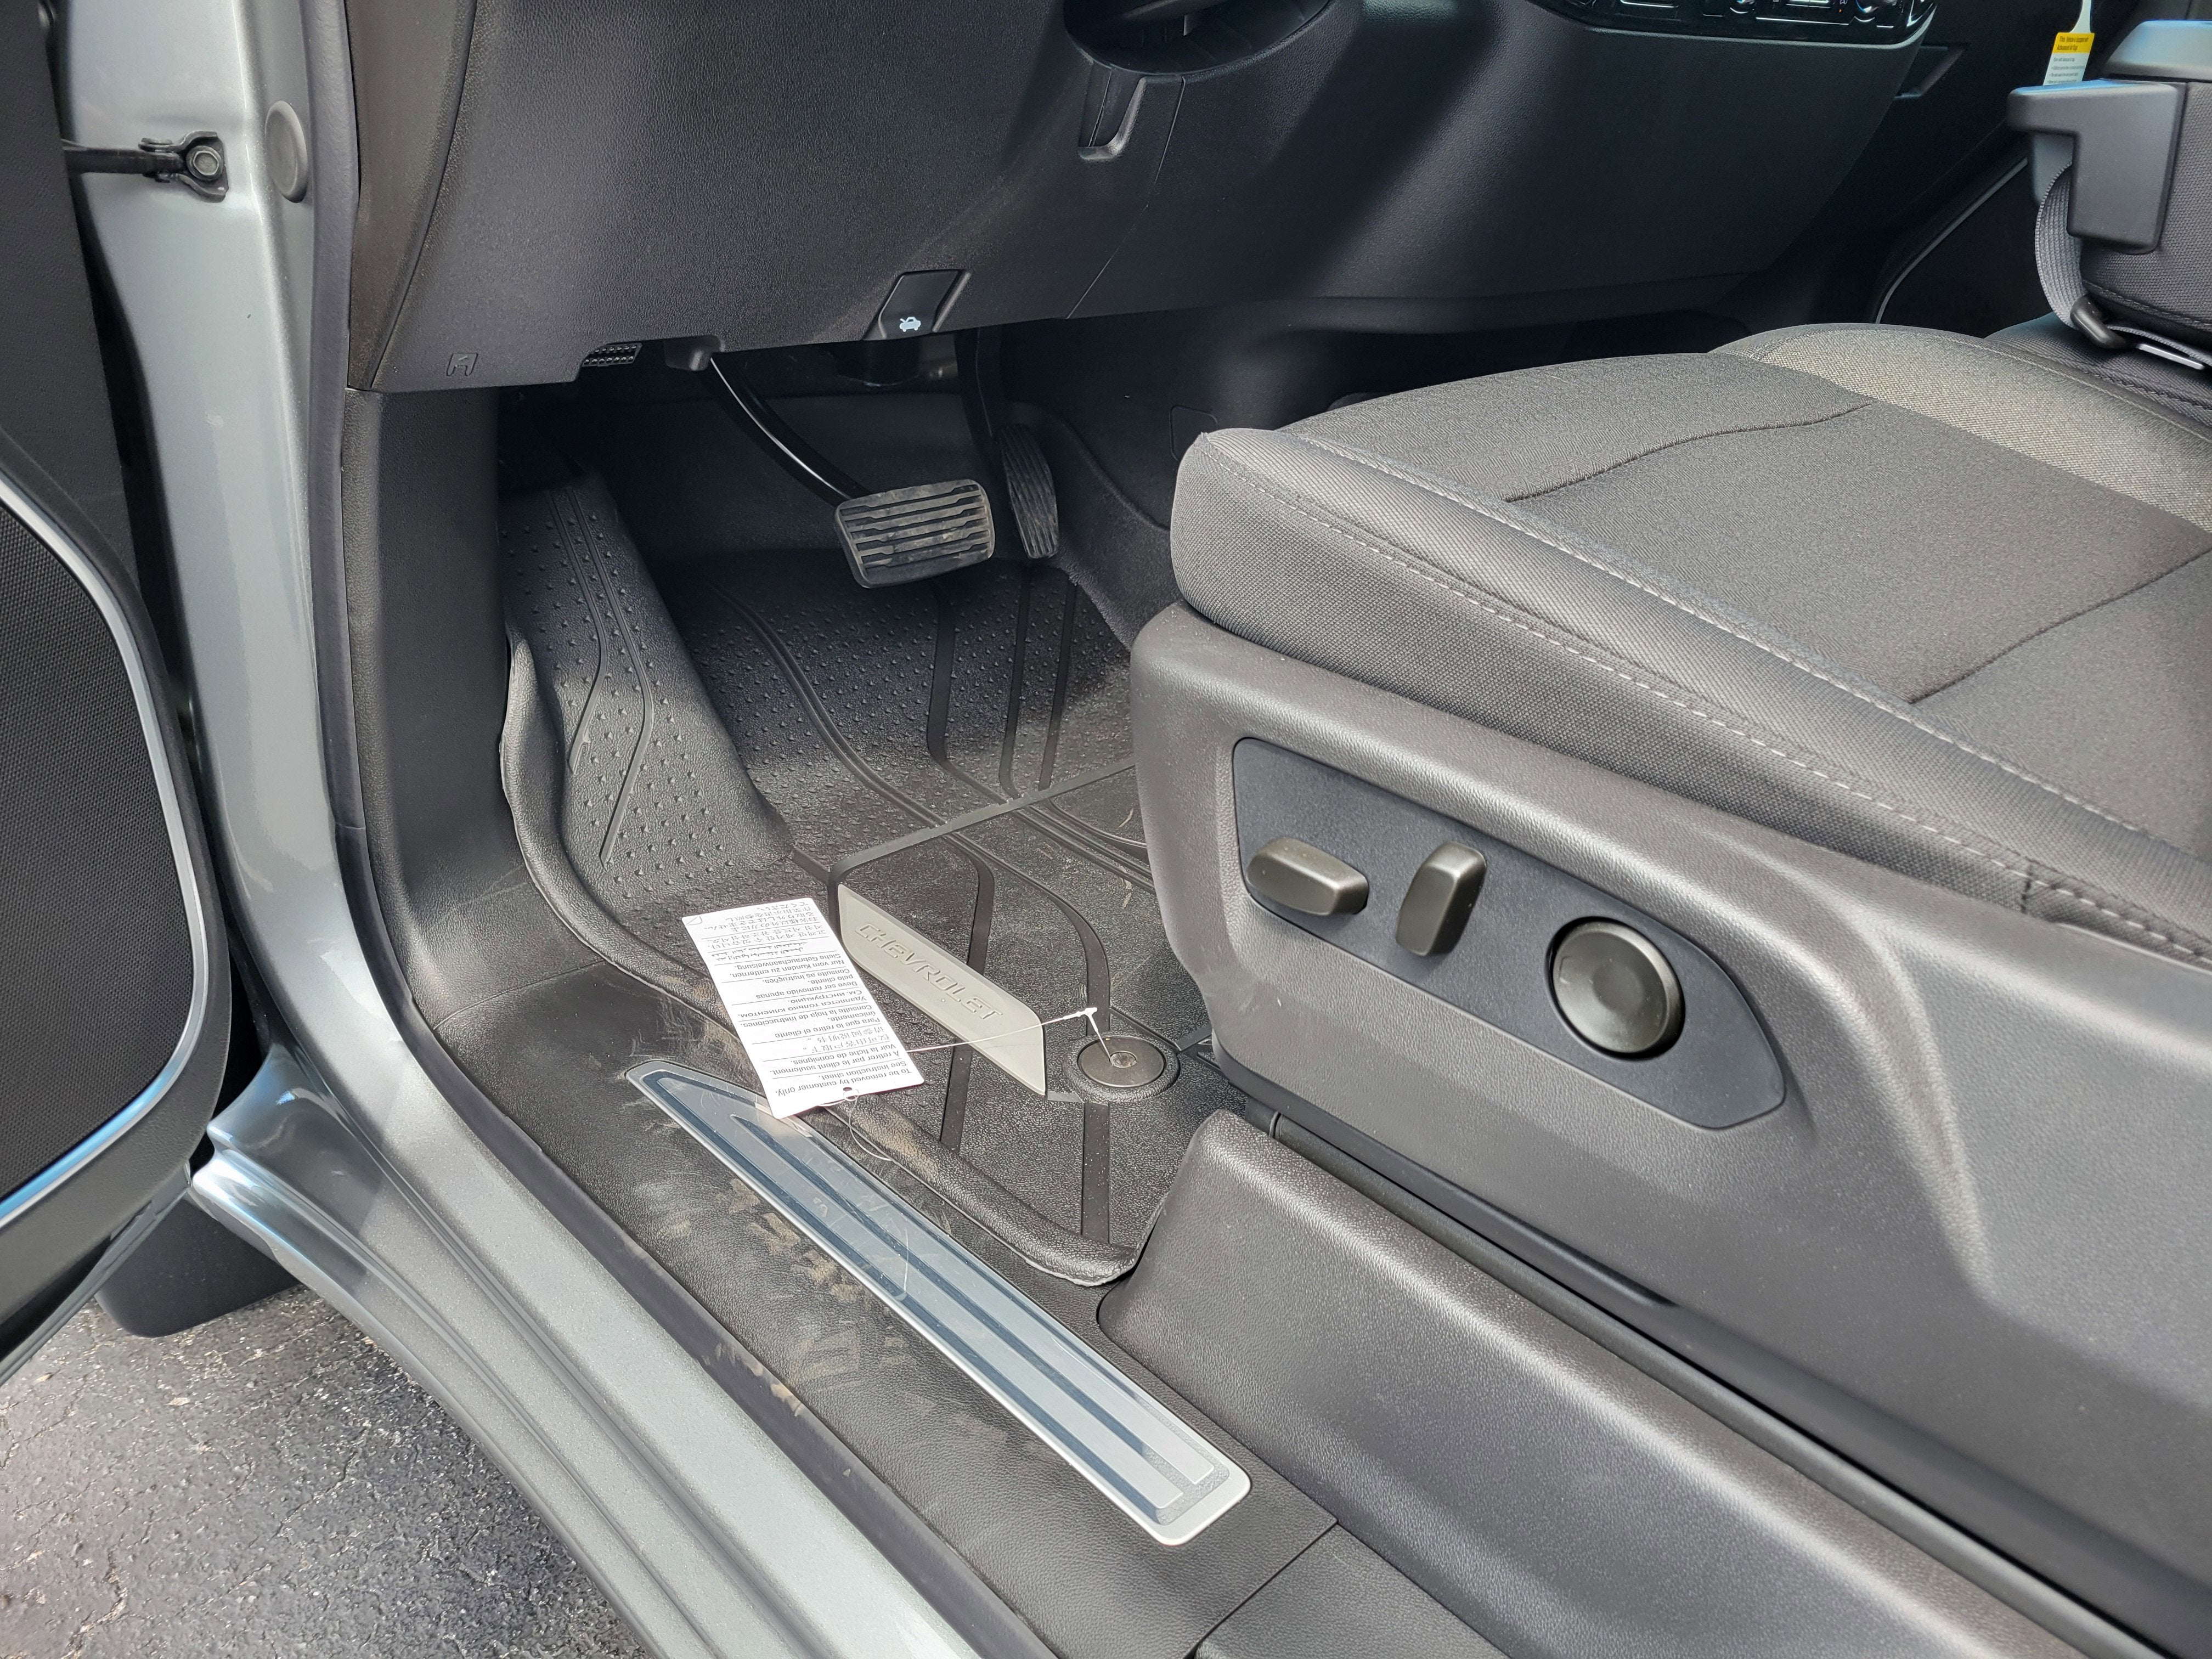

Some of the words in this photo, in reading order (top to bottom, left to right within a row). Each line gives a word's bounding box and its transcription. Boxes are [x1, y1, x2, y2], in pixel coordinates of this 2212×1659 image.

[734, 956, 818, 970] Gebrauchsanweisung.
[730, 969, 769, 978] entfernen.
[817, 968, 850, 977] Consulte
[856, 924, 1003, 1019] CHEVROLET
[762, 974, 805, 984] instruções.
[755, 991, 785, 999] apenas
[786, 986, 822, 995] removido
[787, 992, 845, 1003] инструкцию.
[821, 996, 867, 1006] Удаляется
[788, 1003, 820, 1011] только
[838, 1005, 872, 1013] Consulte
[738, 1008, 786, 1018] клиентом.
[827, 1011, 876, 1022] únicamente.
[740, 1016, 797, 1028] instrucciones.
[791, 1055, 834, 1065] consignes.
[868, 1052, 891, 1060] retirer
[770, 1065, 816, 1075] seulement.
[817, 1062, 840, 1070] client
[845, 1064, 890, 1076] instruction
[819, 1073, 844, 1081] sheet.
[851, 1073, 887, 1084] removed
[798, 1081, 837, 1091] customer
[775, 1087, 795, 1097] only.
